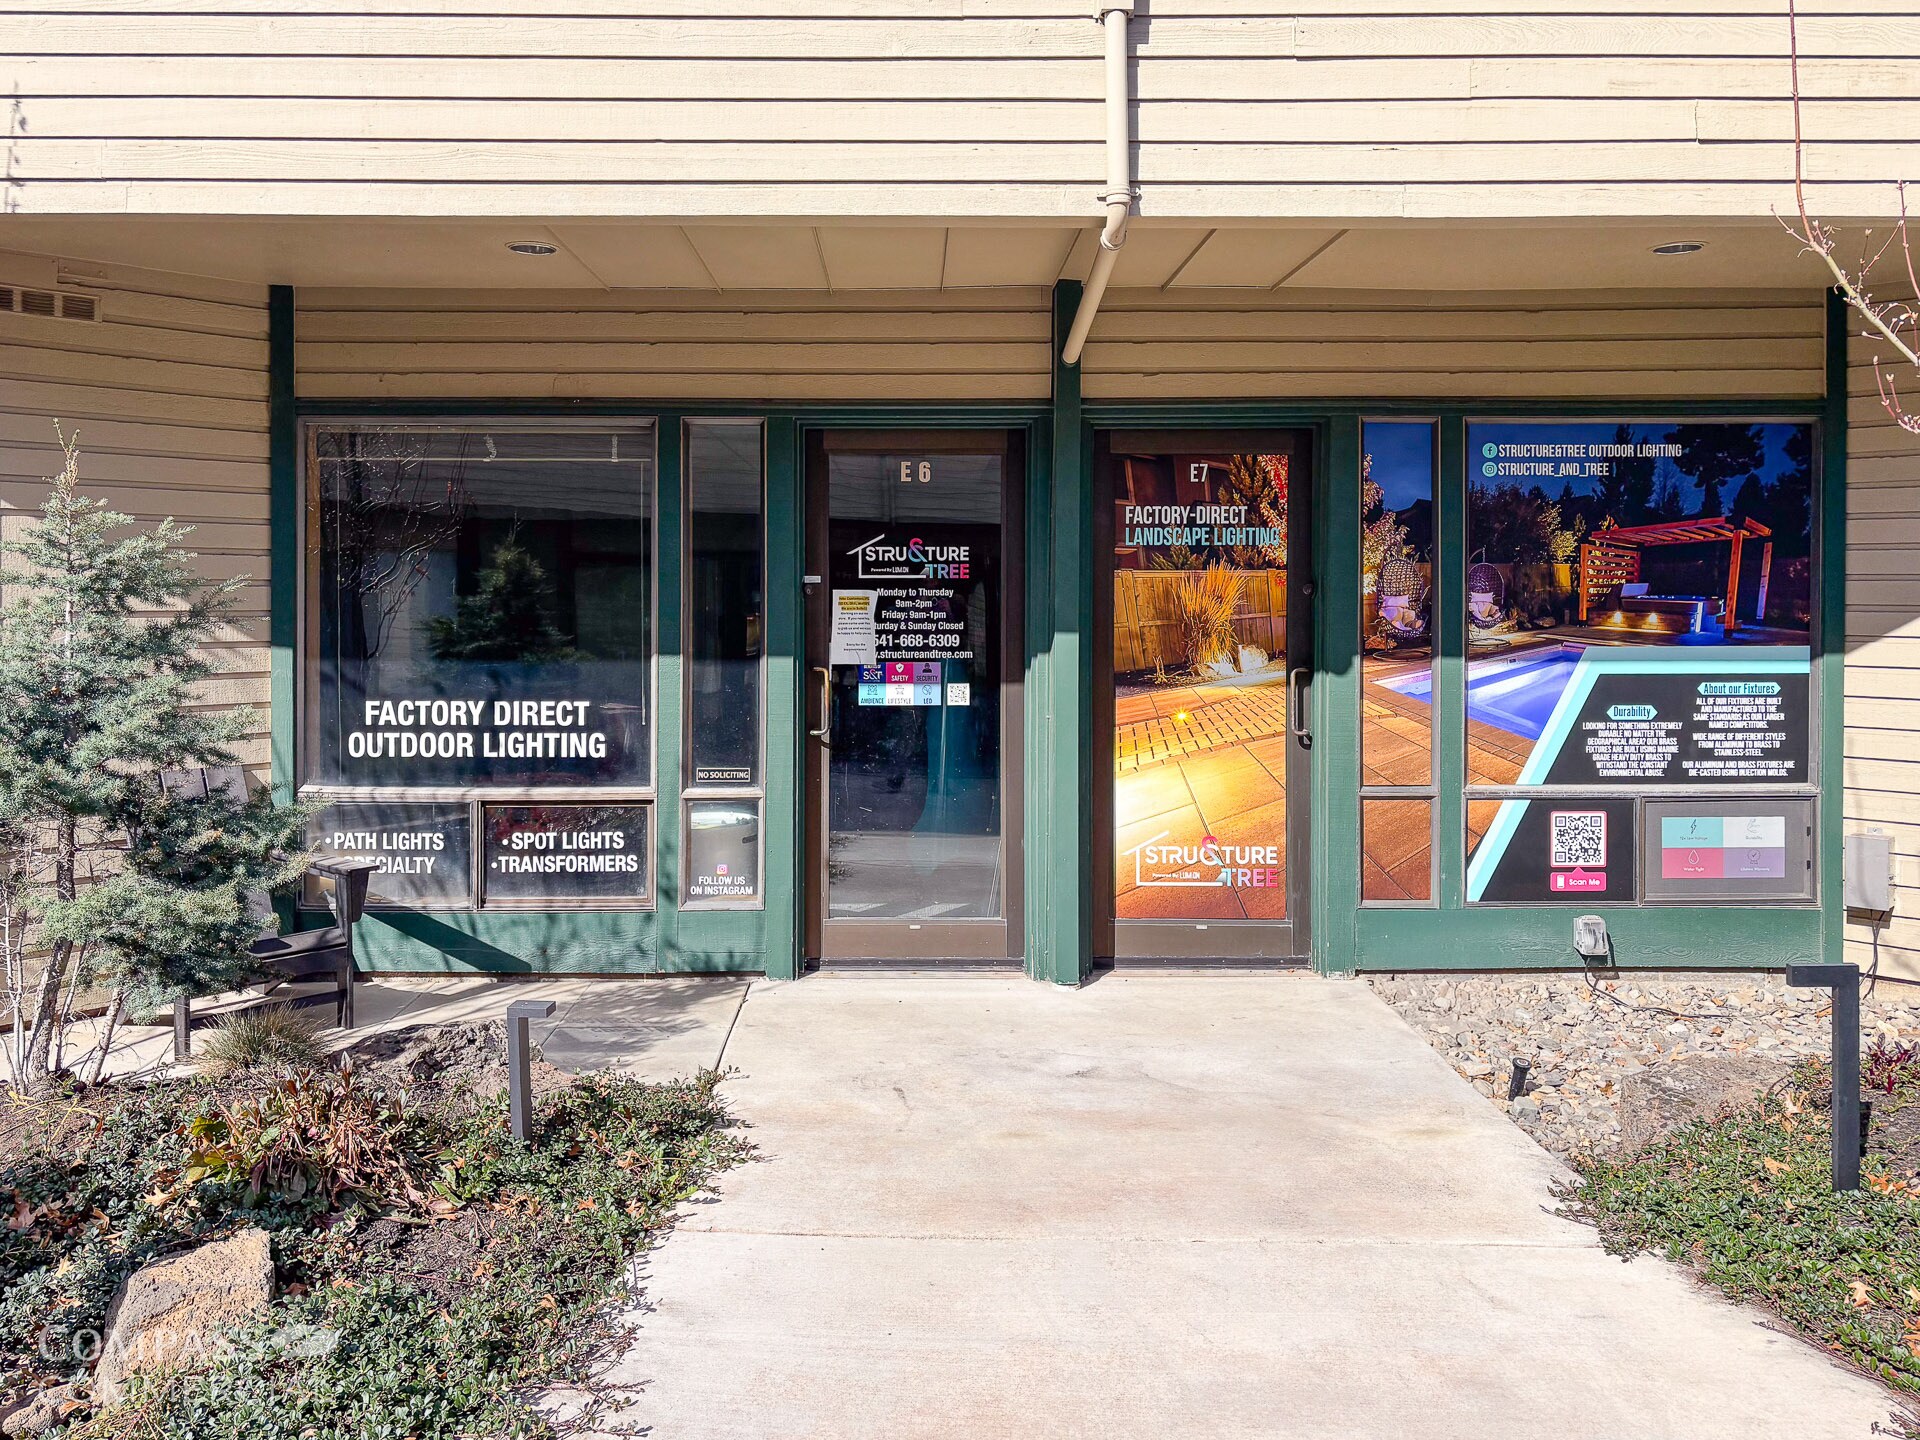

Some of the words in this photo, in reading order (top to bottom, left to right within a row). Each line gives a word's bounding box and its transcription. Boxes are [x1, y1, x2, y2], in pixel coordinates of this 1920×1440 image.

[1498, 444, 1586, 458] STRUCTURE&TREE
[1589, 444, 1634, 458] OUTDOOR
[1637, 444, 1682, 458] LIGHTING
[1190, 463, 1209, 483] E7
[1498, 463, 1609, 477] STRUCTURE_AND_TREE
[1125, 505, 1248, 524] FACTORY-DIRECT
[1125, 527, 1210, 546] LANDSCAPE
[1213, 527, 1280, 546] LIGHTING
[924, 563, 970, 579] TREE
[877, 588, 907, 598] Monday
[909, 588, 917, 598] to
[918, 588, 954, 598] Thursday
[895, 599, 932, 609] 9am-2pm
[881, 611, 908, 620] Friday:
[909, 611, 946, 620] 9am-1pm
[874, 622, 899, 631] turday
[900, 621, 907, 630] &
[908, 622, 937, 631] Sunday
[938, 622, 964, 630] Closed
[874, 634, 960, 647] 541-668-6309
[1703, 683, 1726, 694] About
[1728, 683, 1741, 694] our
[1743, 683, 1775, 694] Fixtures
[1696, 697, 1706, 705] ALL
[1707, 697, 1715, 705] OF
[1715, 697, 1727, 705] OUR
[1727, 697, 1754, 705] FIXTURES
[1755, 697, 1766, 705] ARE
[1767, 697, 1782, 705] BUILT
[364, 700, 484, 727] FACTORY
[493, 700, 590, 727] DIRECT
[1613, 706, 1651, 719] Durability
[1700, 705, 1712, 713] AND
[1758, 705, 1765, 713] TO
[1766, 705, 1777, 713] THE
[1693, 713, 1709, 721] SAME
[1709, 713, 1742, 721] STANDARDS
[1742, 713, 1750, 721] AS
[1750, 713, 1762, 721] OUR
[1763, 713, 1785, 721] LARGER
[1582, 722, 1605, 730] LOOKING
[1607, 722, 1617, 730] FOR
[1618, 722, 1650, 730] SOMETHING
[1651, 722, 1683, 730] EXTREMELY
[1708, 721, 1728, 729] NAMED
[1598, 730, 1623, 738] DURABLE
[1624, 730, 1632, 738] NO
[1632, 730, 1654, 738] MATTER
[1655, 730, 1666, 738] THE
[1692, 733, 1707, 741] WIDE
[1708, 733, 1726, 741] RANGE
[1727, 733, 1734, 741] OF
[1735, 733, 1764, 741] DIFFERENT
[1765, 733, 1786, 741] STYLES
[347, 732, 474, 759] OUTDOOR
[482, 732, 607, 759] LIGHTING
[1628, 737, 1646, 745] AREA?
[1647, 737, 1658, 745] OUR
[1660, 737, 1677, 745] BRASS
[1698, 741, 1714, 749] FROM
[1745, 741, 1753, 749] TO
[1754, 741, 1772, 749] BRASS
[1772, 741, 1780, 749] TO
[1586, 745, 1612, 753] FIXTURES
[1612, 745, 1623, 753] ARE
[1624, 745, 1639, 753] BUILT
[1640, 745, 1656, 753] USING
[1657, 745, 1679, 753] MARINE
[1592, 753, 1611, 761] GRADE
[1611, 753, 1630, 761] HEAVY
[1629, 753, 1645, 761] DUTY
[1645, 753, 1663, 761] BRASS
[1664, 753, 1672, 761] TO
[1596, 761, 1628, 769] WITHSTAND
[1628, 761, 1639, 769] THE
[1639, 761, 1668, 769] CONSTANT
[1682, 761, 1694, 769] OUR
[1725, 761, 1737, 769] AND
[1738, 761, 1756, 769] BRASS
[1756, 761, 1783, 769] FIXTURES
[1783, 761, 1795, 769] ARE
[698, 771, 709, 779] NO
[710, 771, 749, 779] SOLICITING
[1645, 769, 1665, 777] ABUSE.
[1721, 769, 1738, 777] USING
[1767, 769, 1789, 777] MOLDS.
[333, 832, 377, 850] PATH
[382, 832, 445, 850] LIGHTS
[511, 833, 557, 850] SPOT
[561, 831, 625, 850] LIGHTS
[343, 856, 436, 874] ECIALTY
[497, 855, 638, 873] TRANSFORMERS
[698, 876, 733, 885] FOLLOW
[734, 876, 746, 885] US
[1220, 867, 1278, 888] TREE
[1569, 878, 1587, 886] Scan
[1589, 878, 1601, 886] Me
[690, 886, 704, 895] ON
[704, 886, 753, 895] INSTAGRAM
